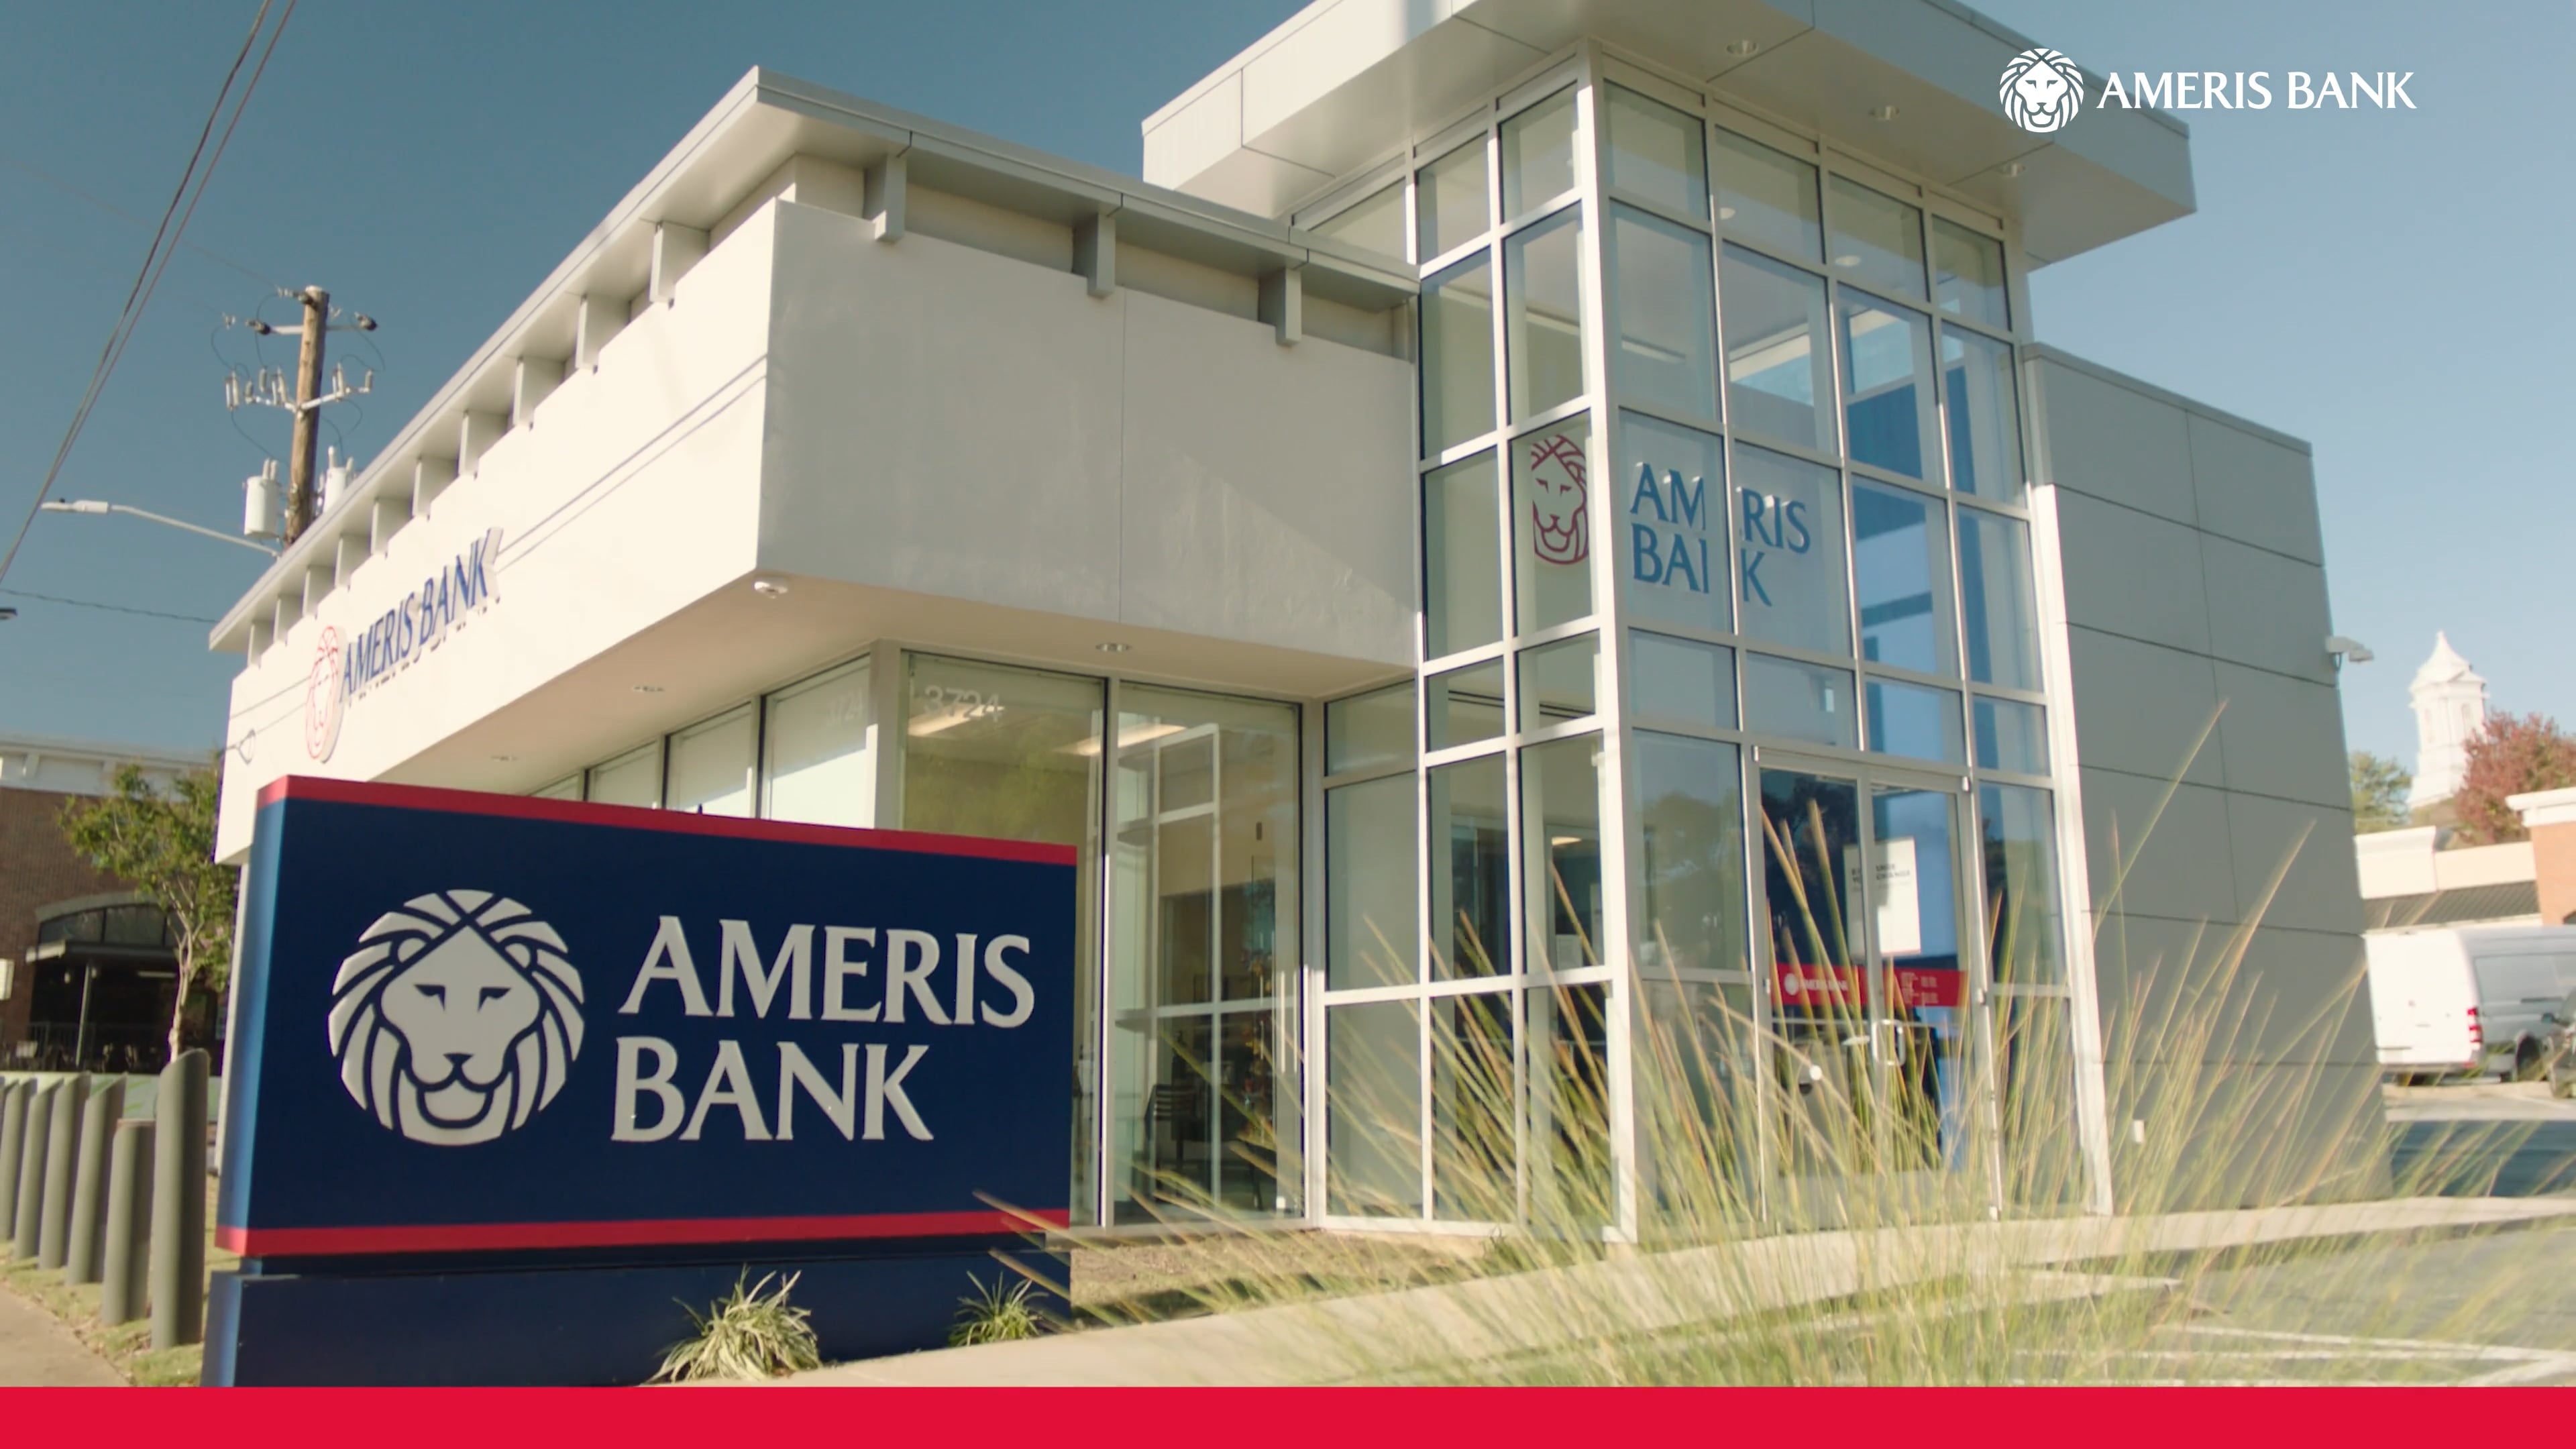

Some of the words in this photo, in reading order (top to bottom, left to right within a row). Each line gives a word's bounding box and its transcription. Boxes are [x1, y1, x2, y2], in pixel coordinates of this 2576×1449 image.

[338, 591, 416, 704] AMERIS
[419, 527, 494, 647] BANK
[924, 685, 1002, 722] 3724
[618, 916, 1034, 1028] AMERIS
[611, 1036, 934, 1142] BANK
